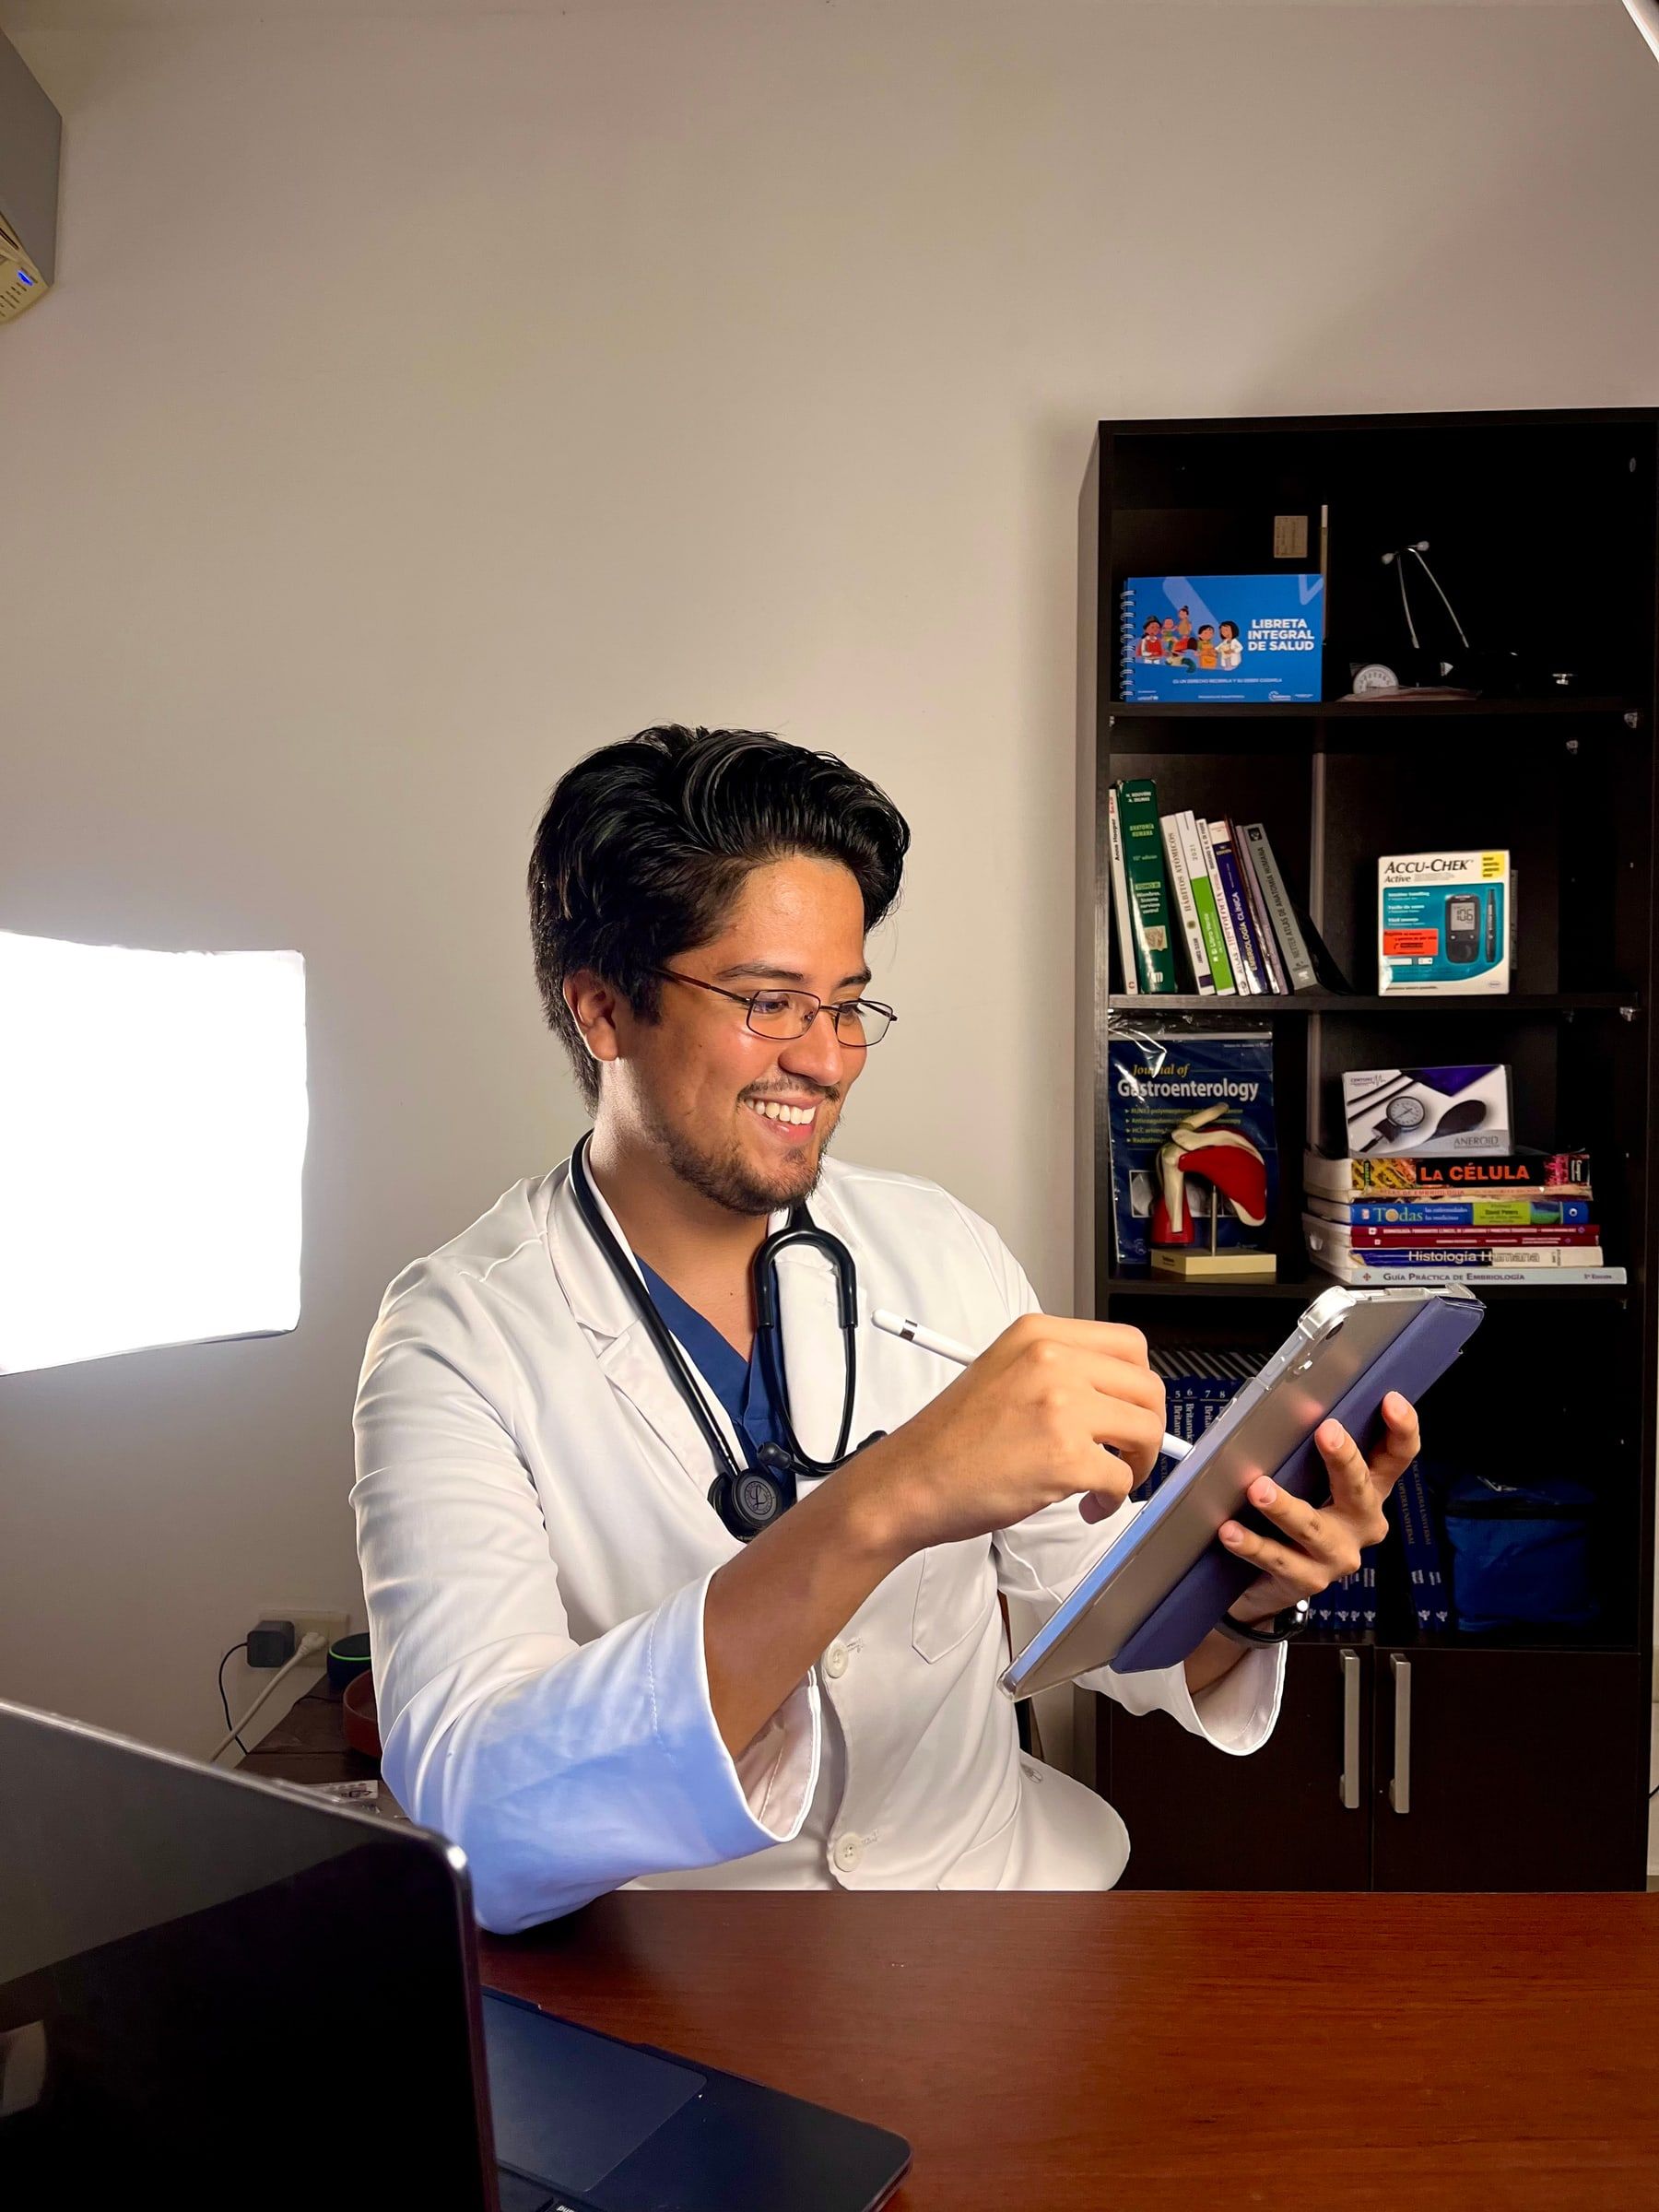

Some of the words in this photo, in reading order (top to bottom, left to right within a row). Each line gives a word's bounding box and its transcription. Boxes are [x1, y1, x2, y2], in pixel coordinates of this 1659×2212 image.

[1252, 618, 1308, 629] LIBRETA
[1248, 629, 1315, 640] INTEGRAL
[1248, 641, 1266, 651] DE
[1269, 641, 1314, 651] SALUD
[1168, 831, 1182, 874] ATÓMICOS
[1256, 846, 1271, 874] HUMANA
[1384, 859, 1470, 874] ACCU-CHEK
[1384, 875, 1411, 883] Active
[1177, 875, 1191, 912] HÁBITOS
[1266, 875, 1283, 908] ANATOMÍA
[1231, 891, 1245, 922] CLÍNICA
[1277, 907, 1286, 917] DE
[1215, 890, 1235, 946] HISTOLOGÍA
[1280, 916, 1292, 936] ATLAS
[1240, 921, 1258, 971] EMBRIOLOGÍA
[1287, 935, 1300, 959] NETTER
[1133, 1064, 1174, 1077] Joual
[1177, 1064, 1190, 1077] of
[1117, 1077, 1259, 1101] Gastroenterology
[1453, 1135, 1500, 1146] ANEROID
[1449, 1162, 1530, 1181] CÉLULA
[1408, 1250, 1477, 1264] Histología
[1481, 1250, 1540, 1263] Humana
[1174, 1390, 1181, 1398] 5
[1204, 1390, 1211, 1398] 7
[1219, 1390, 1226, 1399] 8
[1173, 1405, 1182, 1439] Britann
